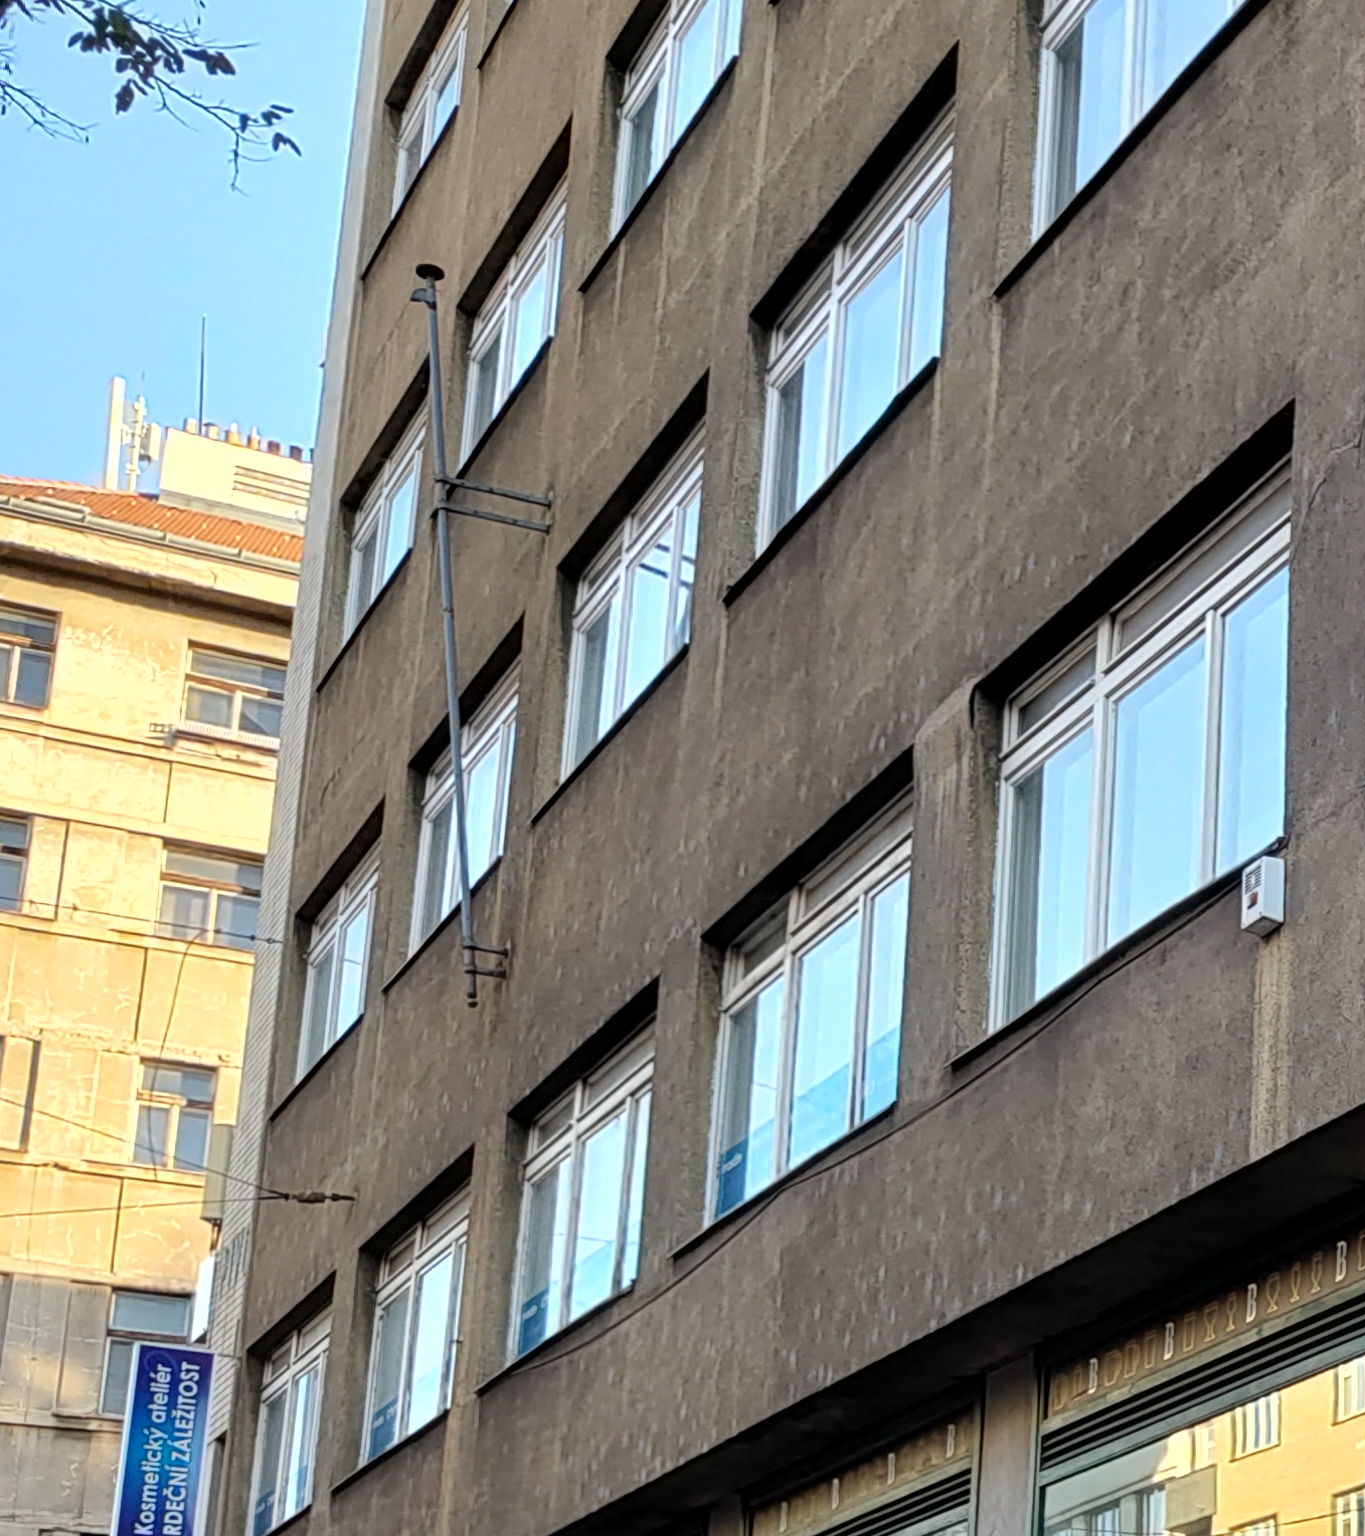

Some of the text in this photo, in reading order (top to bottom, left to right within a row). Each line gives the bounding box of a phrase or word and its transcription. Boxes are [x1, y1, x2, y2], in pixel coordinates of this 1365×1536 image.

[133, 1363, 172, 1536] Kosmetický ateliér
[167, 1361, 201, 1463] ZÁLEŽITOST
